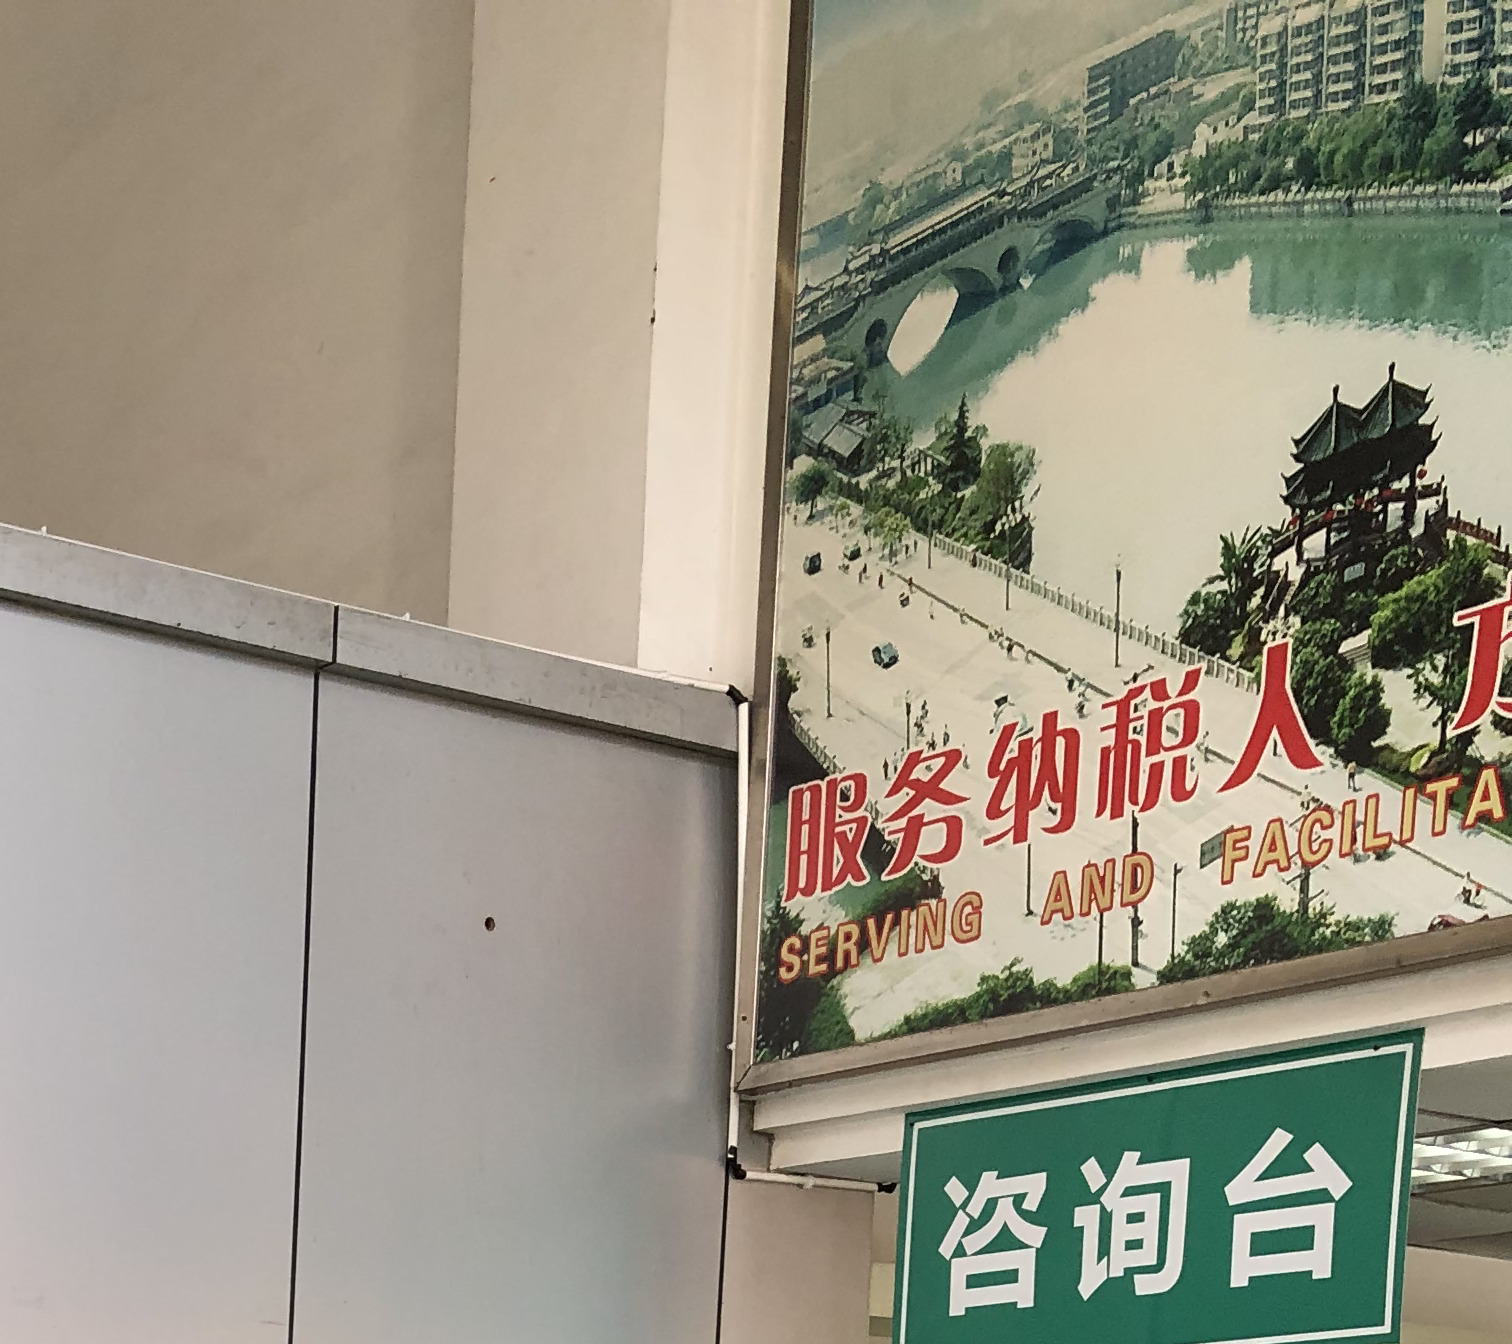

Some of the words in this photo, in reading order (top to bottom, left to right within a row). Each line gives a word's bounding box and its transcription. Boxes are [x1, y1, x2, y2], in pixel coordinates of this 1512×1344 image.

[777, 890, 984, 985] SERVING
[1041, 851, 1155, 926] AND
[1220, 764, 1506, 886] FACILITA
[781, 637, 1324, 903] 服务纳税人
[938, 1127, 1354, 1318] 咨询台
